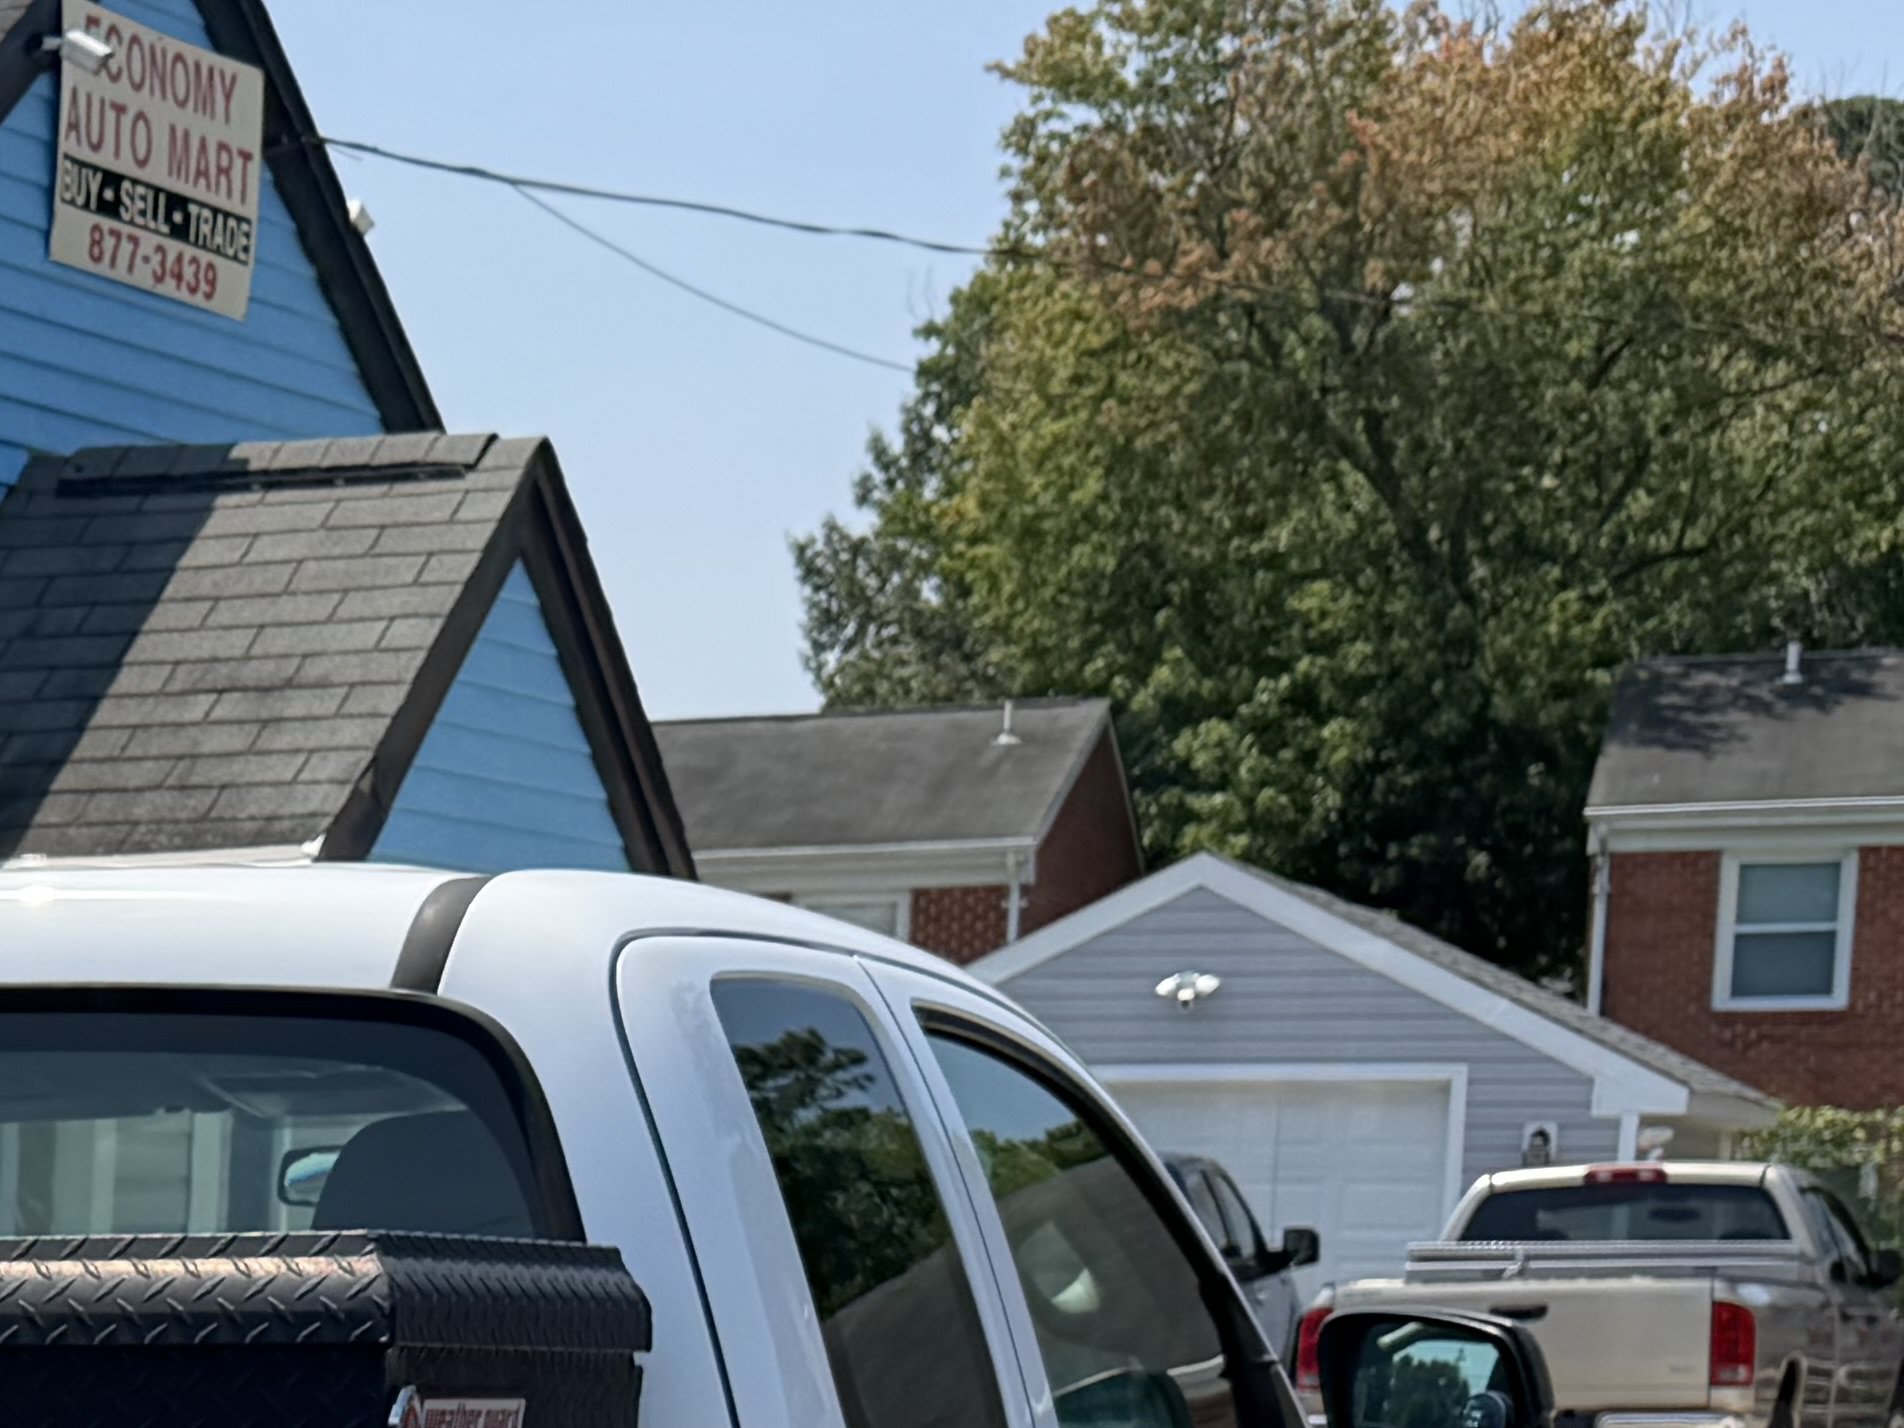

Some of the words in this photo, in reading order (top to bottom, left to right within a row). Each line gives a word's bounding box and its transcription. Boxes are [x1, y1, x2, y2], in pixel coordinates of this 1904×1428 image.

[85, 15, 238, 126] CONOMY
[64, 86, 152, 169] AUTO
[168, 123, 255, 205] MART
[60, 159, 104, 212] BUY
[119, 179, 171, 235] SELL
[187, 204, 251, 264] TRADE
[88, 223, 218, 302] 877-3439
